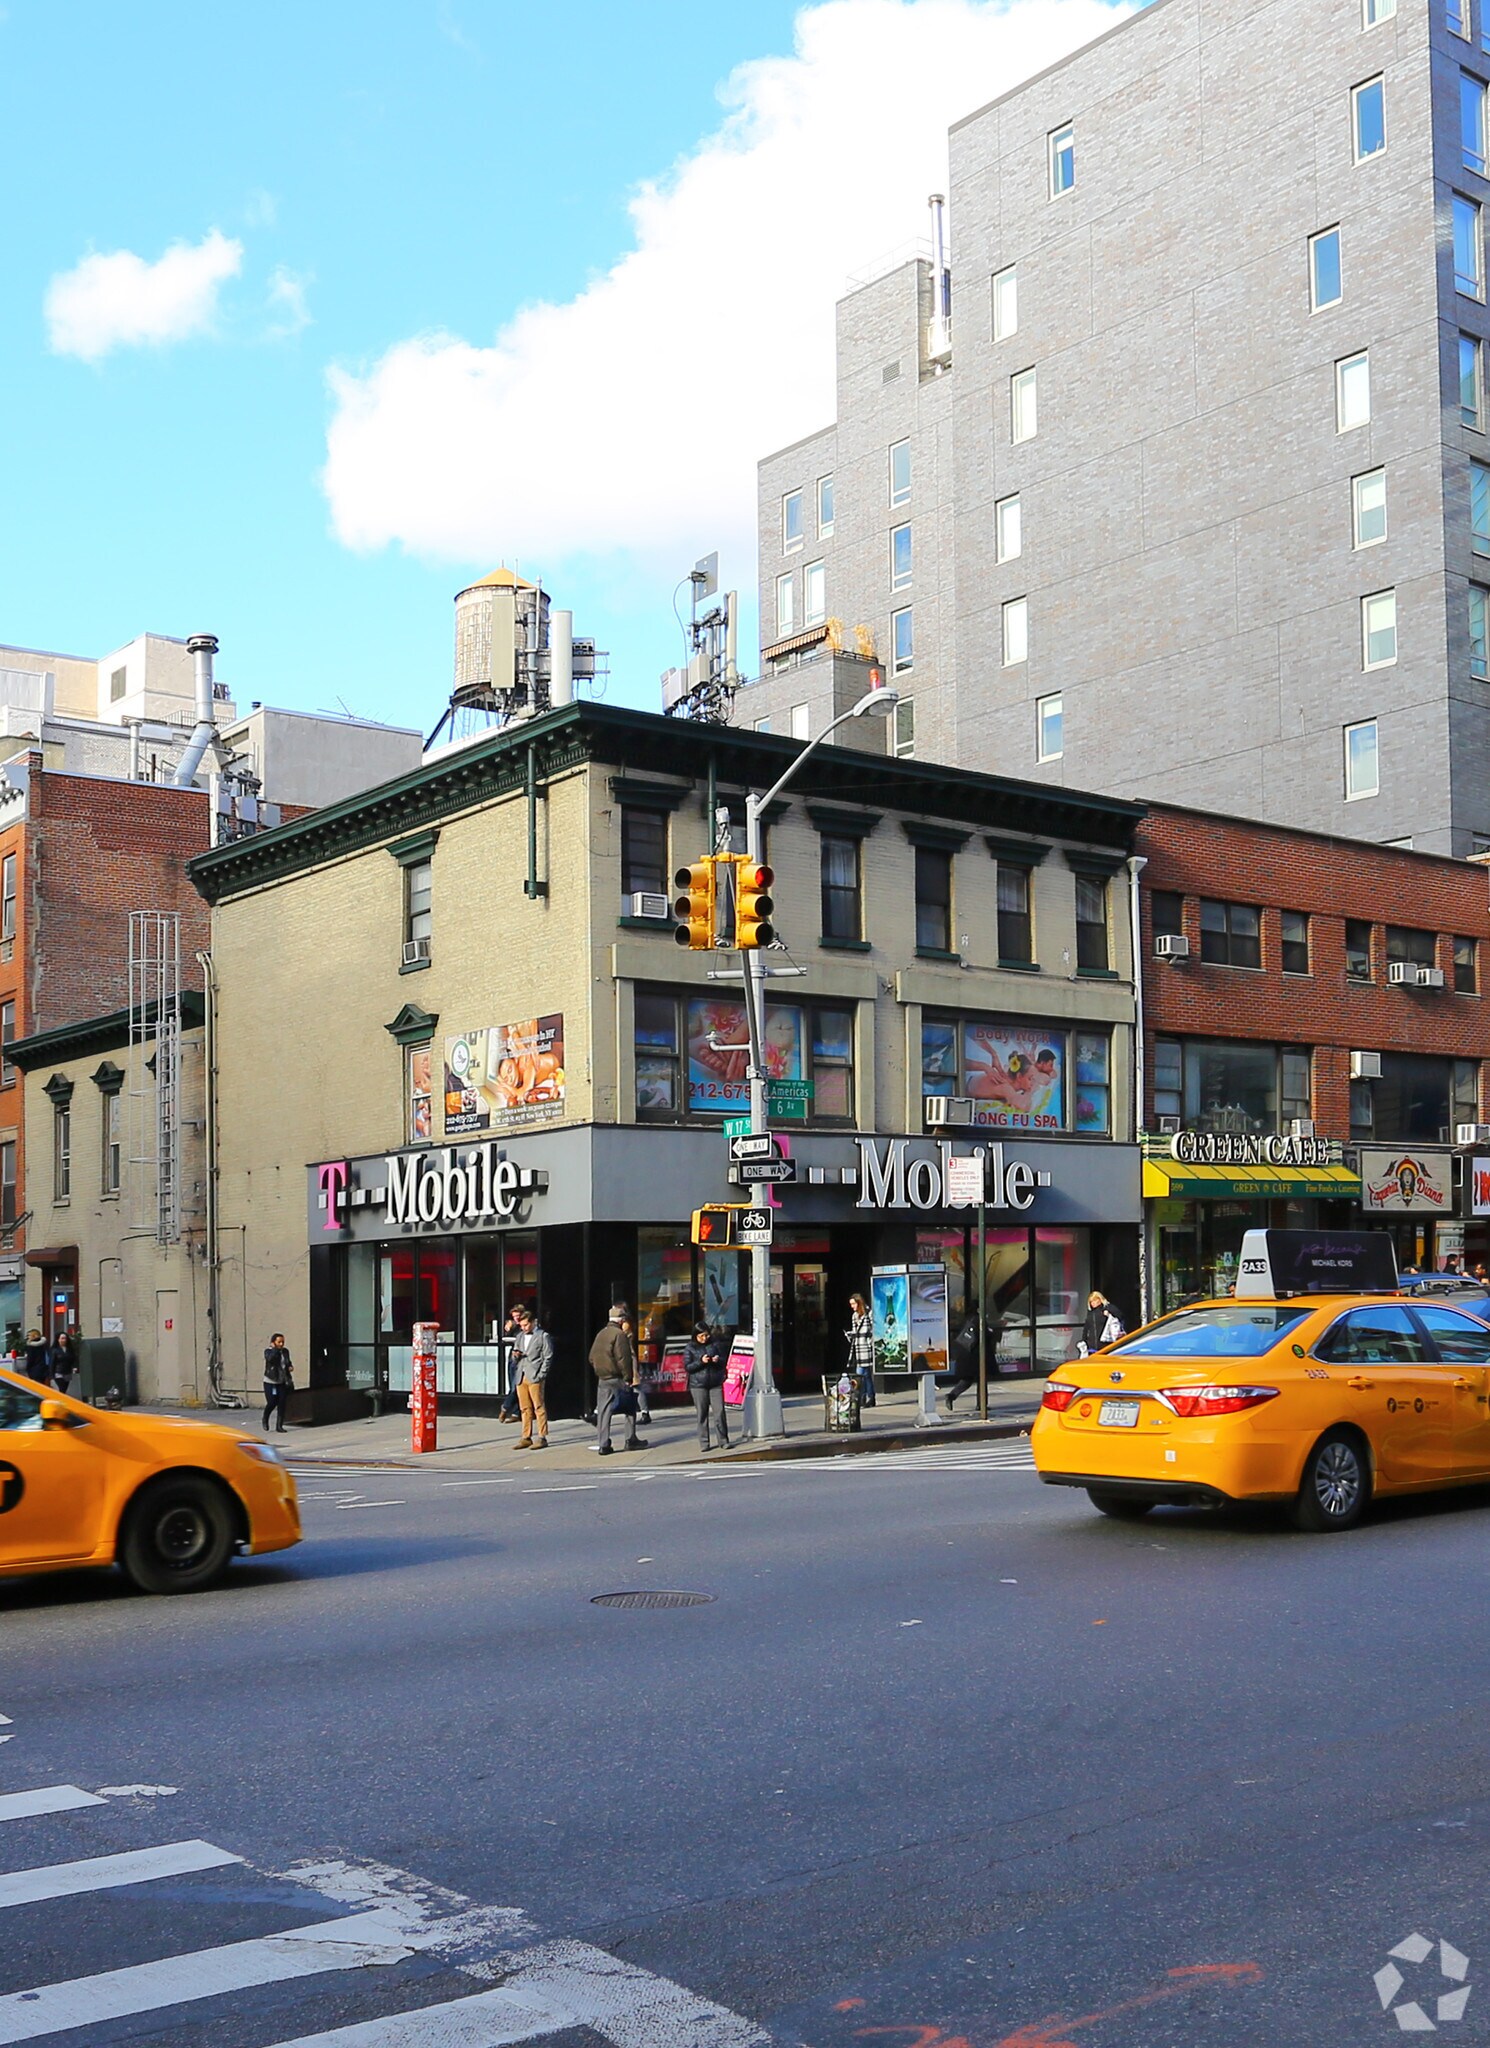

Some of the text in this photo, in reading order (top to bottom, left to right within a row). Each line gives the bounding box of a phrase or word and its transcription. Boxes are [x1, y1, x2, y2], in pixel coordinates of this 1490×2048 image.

[975, 1027, 1050, 1044] Body Work
[771, 1086, 809, 1097] Americas
[777, 1100, 795, 1114] 6 Av
[1012, 1113, 1029, 1126] FU
[1034, 1114, 1058, 1128] SPA
[725, 1122, 734, 1135] W
[735, 1120, 743, 1134] 17
[736, 1140, 765, 1152] ONE WAY
[1171, 1131, 1329, 1166] GREEN CAFE
[747, 1165, 788, 1176] ONE WAY
[1233, 1183, 1292, 1193] GREEN CAFE
[1416, 1177, 1444, 1204] Diana
[738, 1231, 770, 1242] BIKE LANE
[1242, 1261, 1267, 1272] 2A33
[1312, 1259, 1337, 1267] MICHAEL
